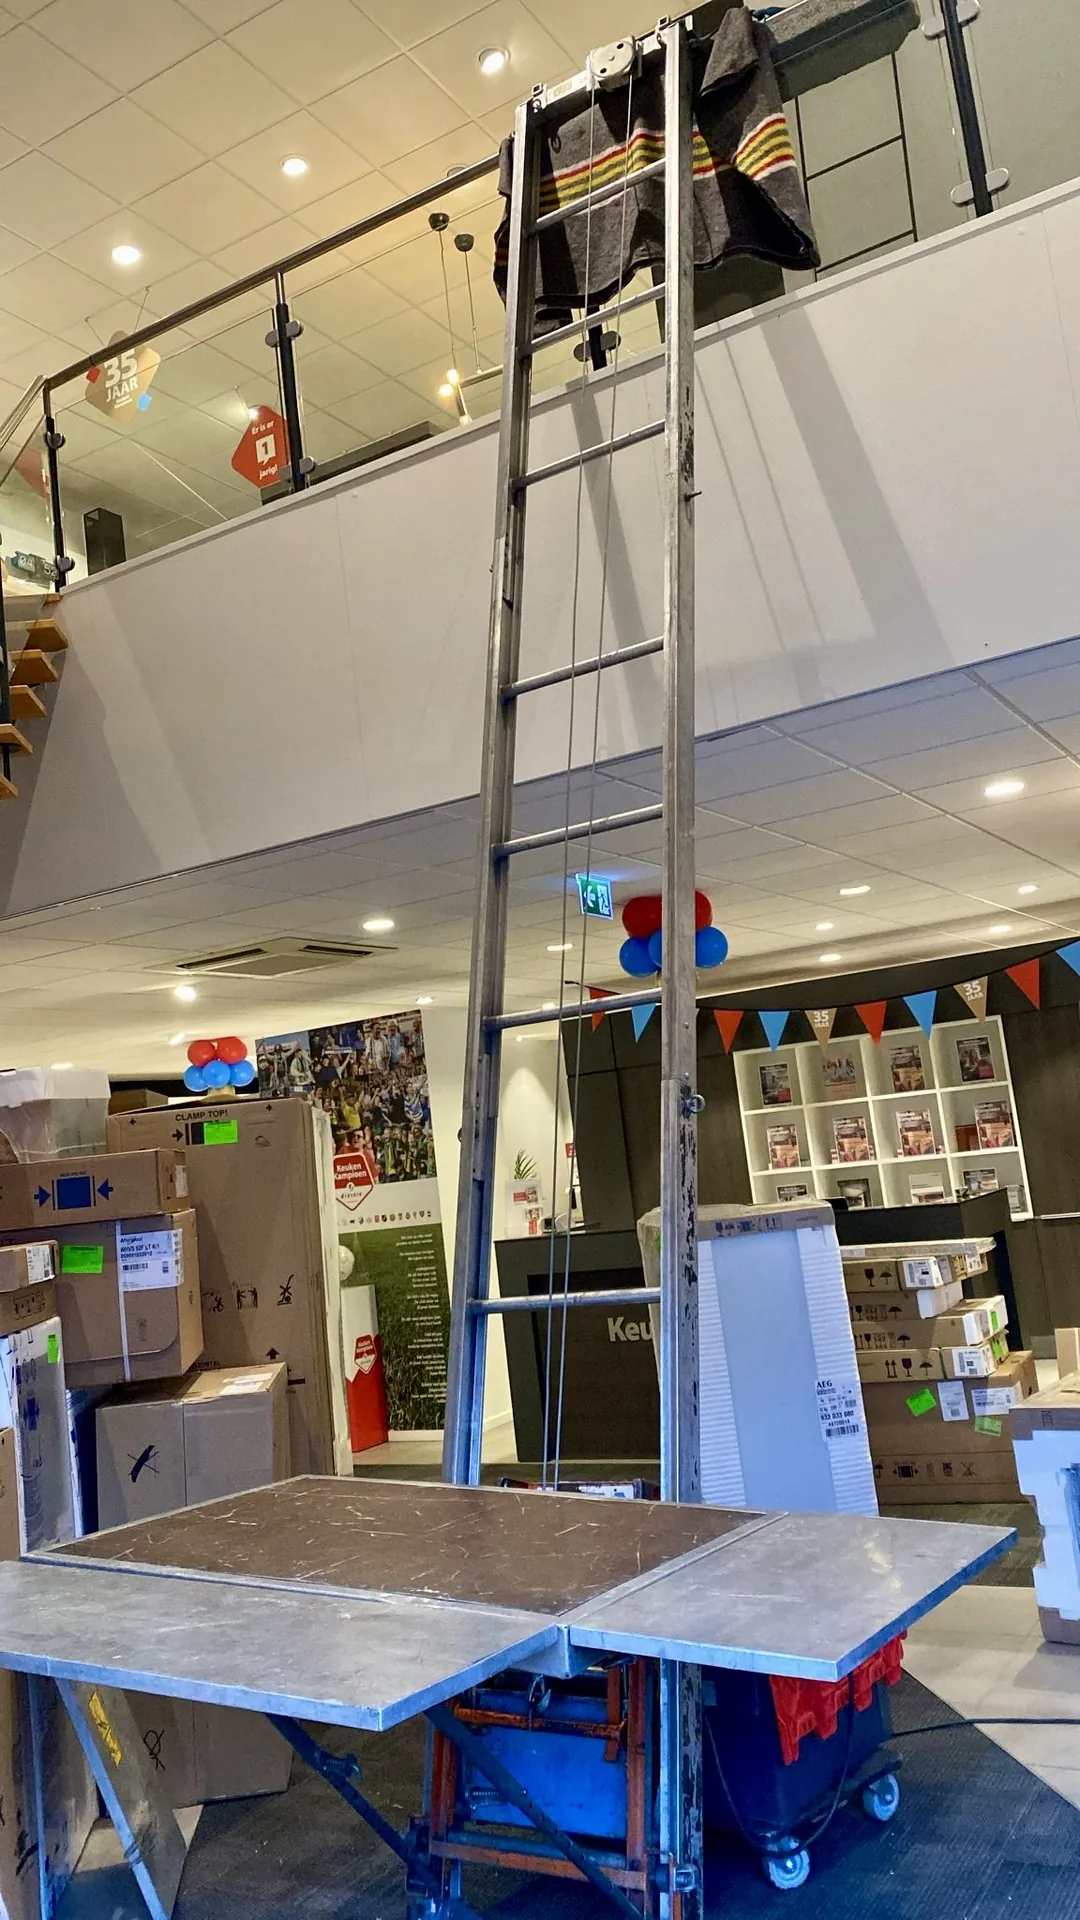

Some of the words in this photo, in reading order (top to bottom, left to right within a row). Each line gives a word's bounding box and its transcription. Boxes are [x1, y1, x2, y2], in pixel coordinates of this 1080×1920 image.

[103, 348, 138, 388] 35
[106, 376, 139, 403] JAAR
[251, 426, 260, 435] Er
[267, 420, 275, 428] er
[259, 464, 278, 480] jarig!
[963, 980, 981, 995] 35
[967, 992, 984, 1001] JAAR
[813, 1010, 829, 1022] 35
[175, 1111, 205, 1121] CLAMP
[207, 1109, 228, 1118] TOP!
[336, 1162, 362, 1172] Keuken
[817, 1380, 833, 1388] AEG
